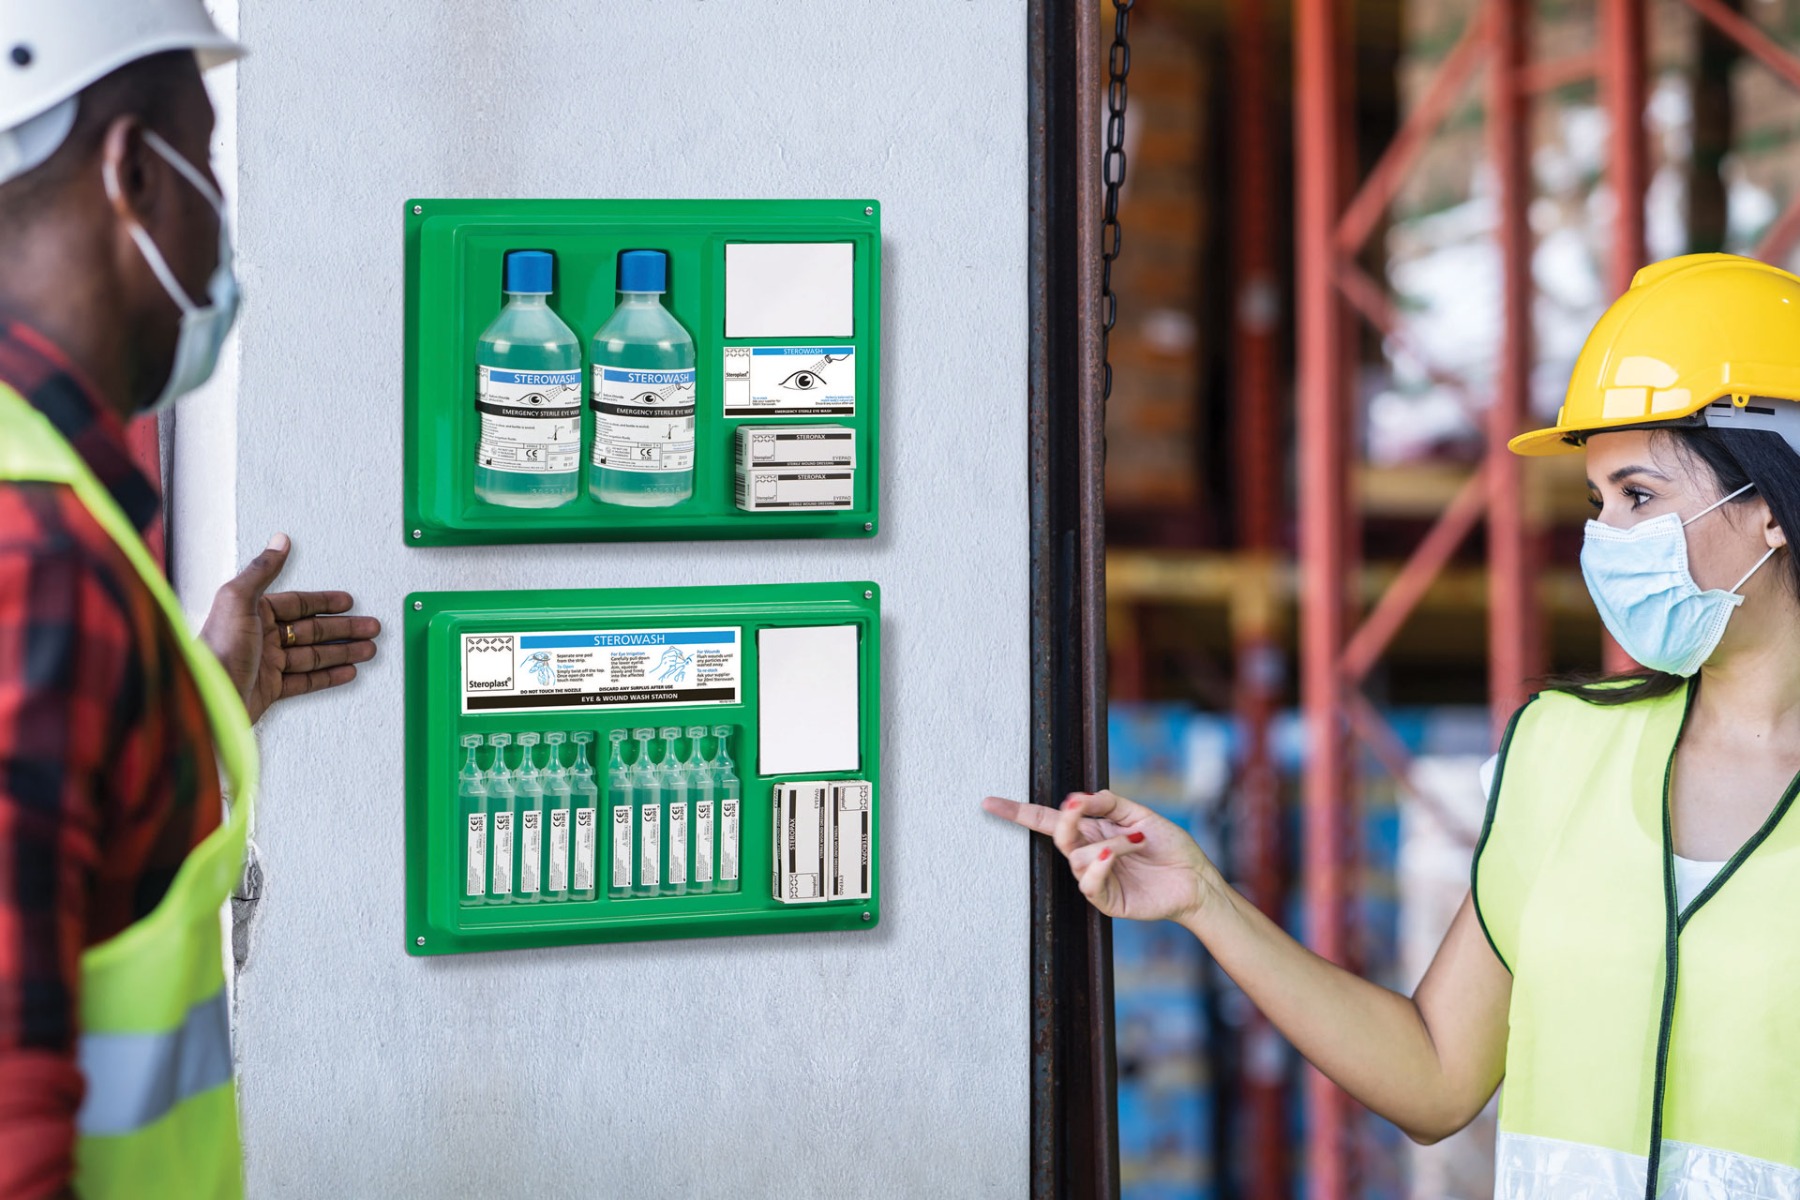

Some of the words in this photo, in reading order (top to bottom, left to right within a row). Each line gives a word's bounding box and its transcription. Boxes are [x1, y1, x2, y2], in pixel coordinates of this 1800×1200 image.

[514, 374, 576, 384] STEROWASH
[628, 373, 689, 383] STEROWASH
[594, 634, 665, 646] STEROWASH
